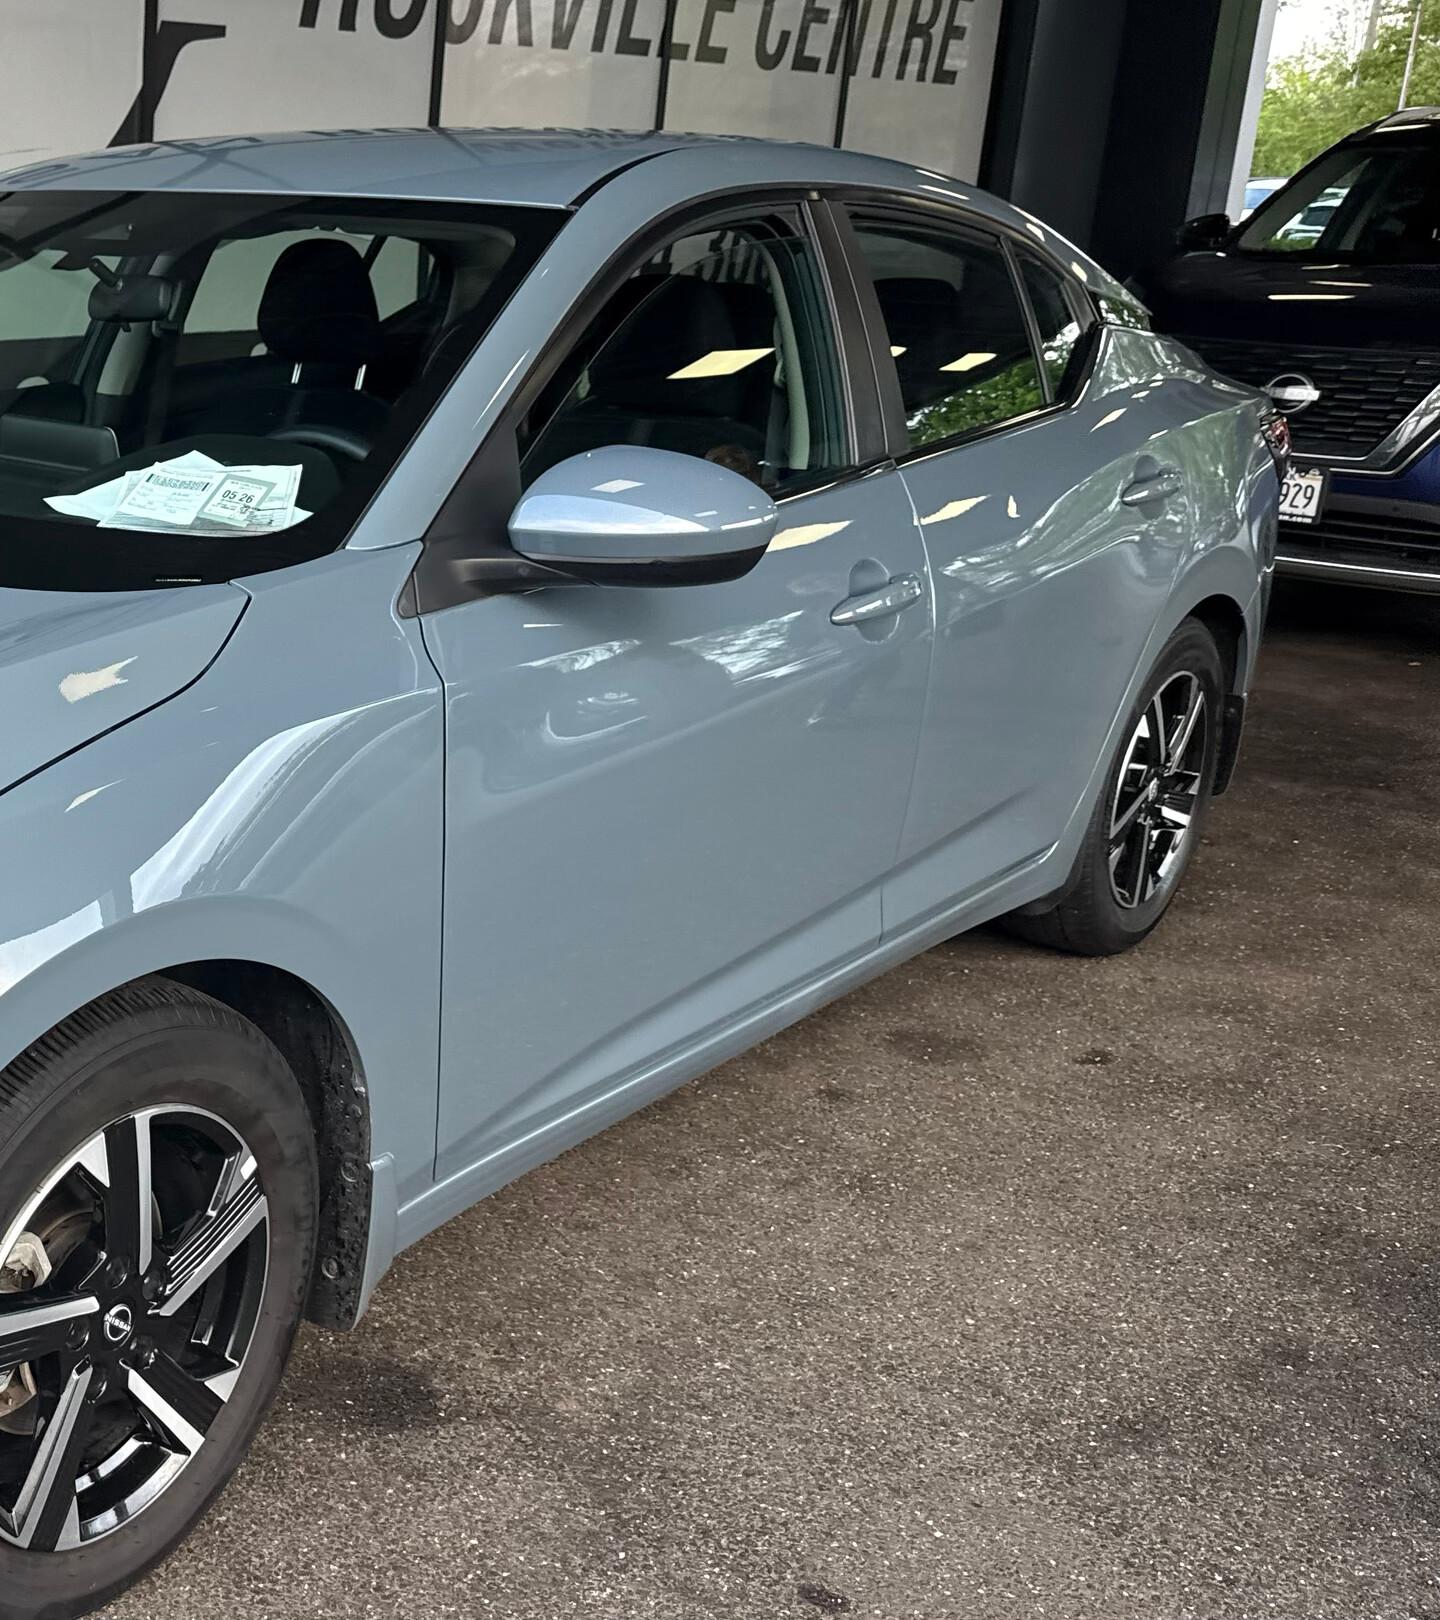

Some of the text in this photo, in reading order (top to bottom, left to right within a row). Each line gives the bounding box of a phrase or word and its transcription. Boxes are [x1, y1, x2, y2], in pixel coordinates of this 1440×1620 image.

[298, 0, 975, 85] VILLE CENTRE
[222, 489, 256, 504] 05 26
[103, 1312, 132, 1332] NISSAN
